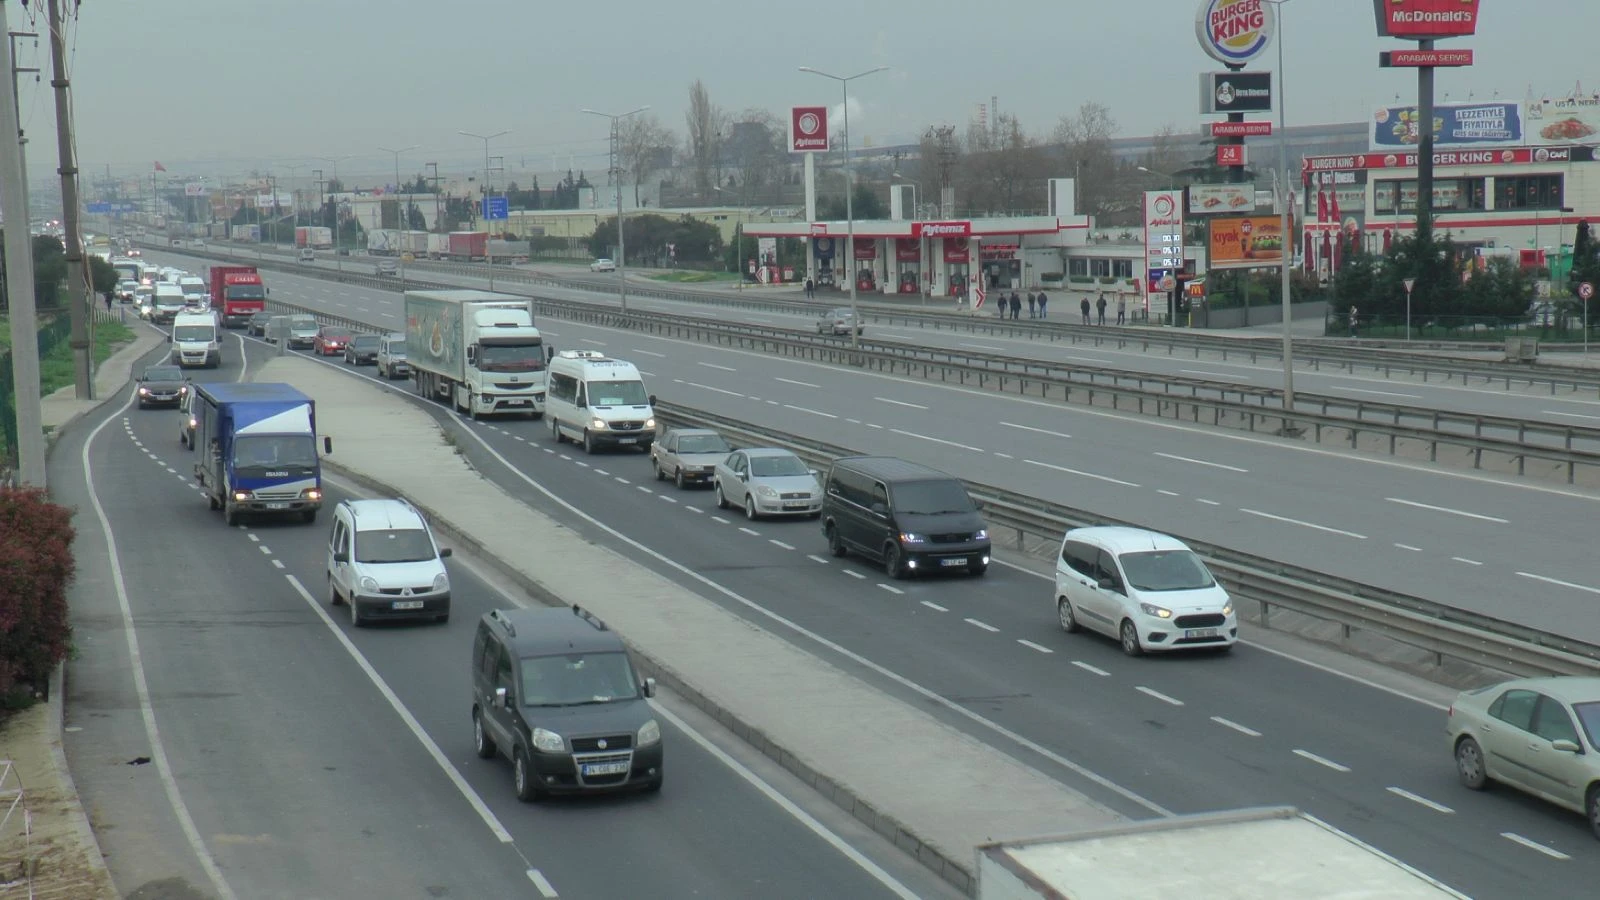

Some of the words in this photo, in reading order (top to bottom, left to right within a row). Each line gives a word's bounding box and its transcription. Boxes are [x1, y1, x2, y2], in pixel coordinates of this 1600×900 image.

[1212, 0, 1260, 25] BURGER
[1392, 10, 1472, 22] McDonald's
[1214, 11, 1264, 43] KING
[1396, 54, 1437, 62] ARABAYA
[1555, 99, 1577, 108] USTA
[1223, 147, 1235, 159] 24
[1405, 153, 1456, 165] BGER
[1459, 152, 1493, 162] KING
[1311, 159, 1337, 169] BURGER
[1337, 157, 1354, 168] KING
